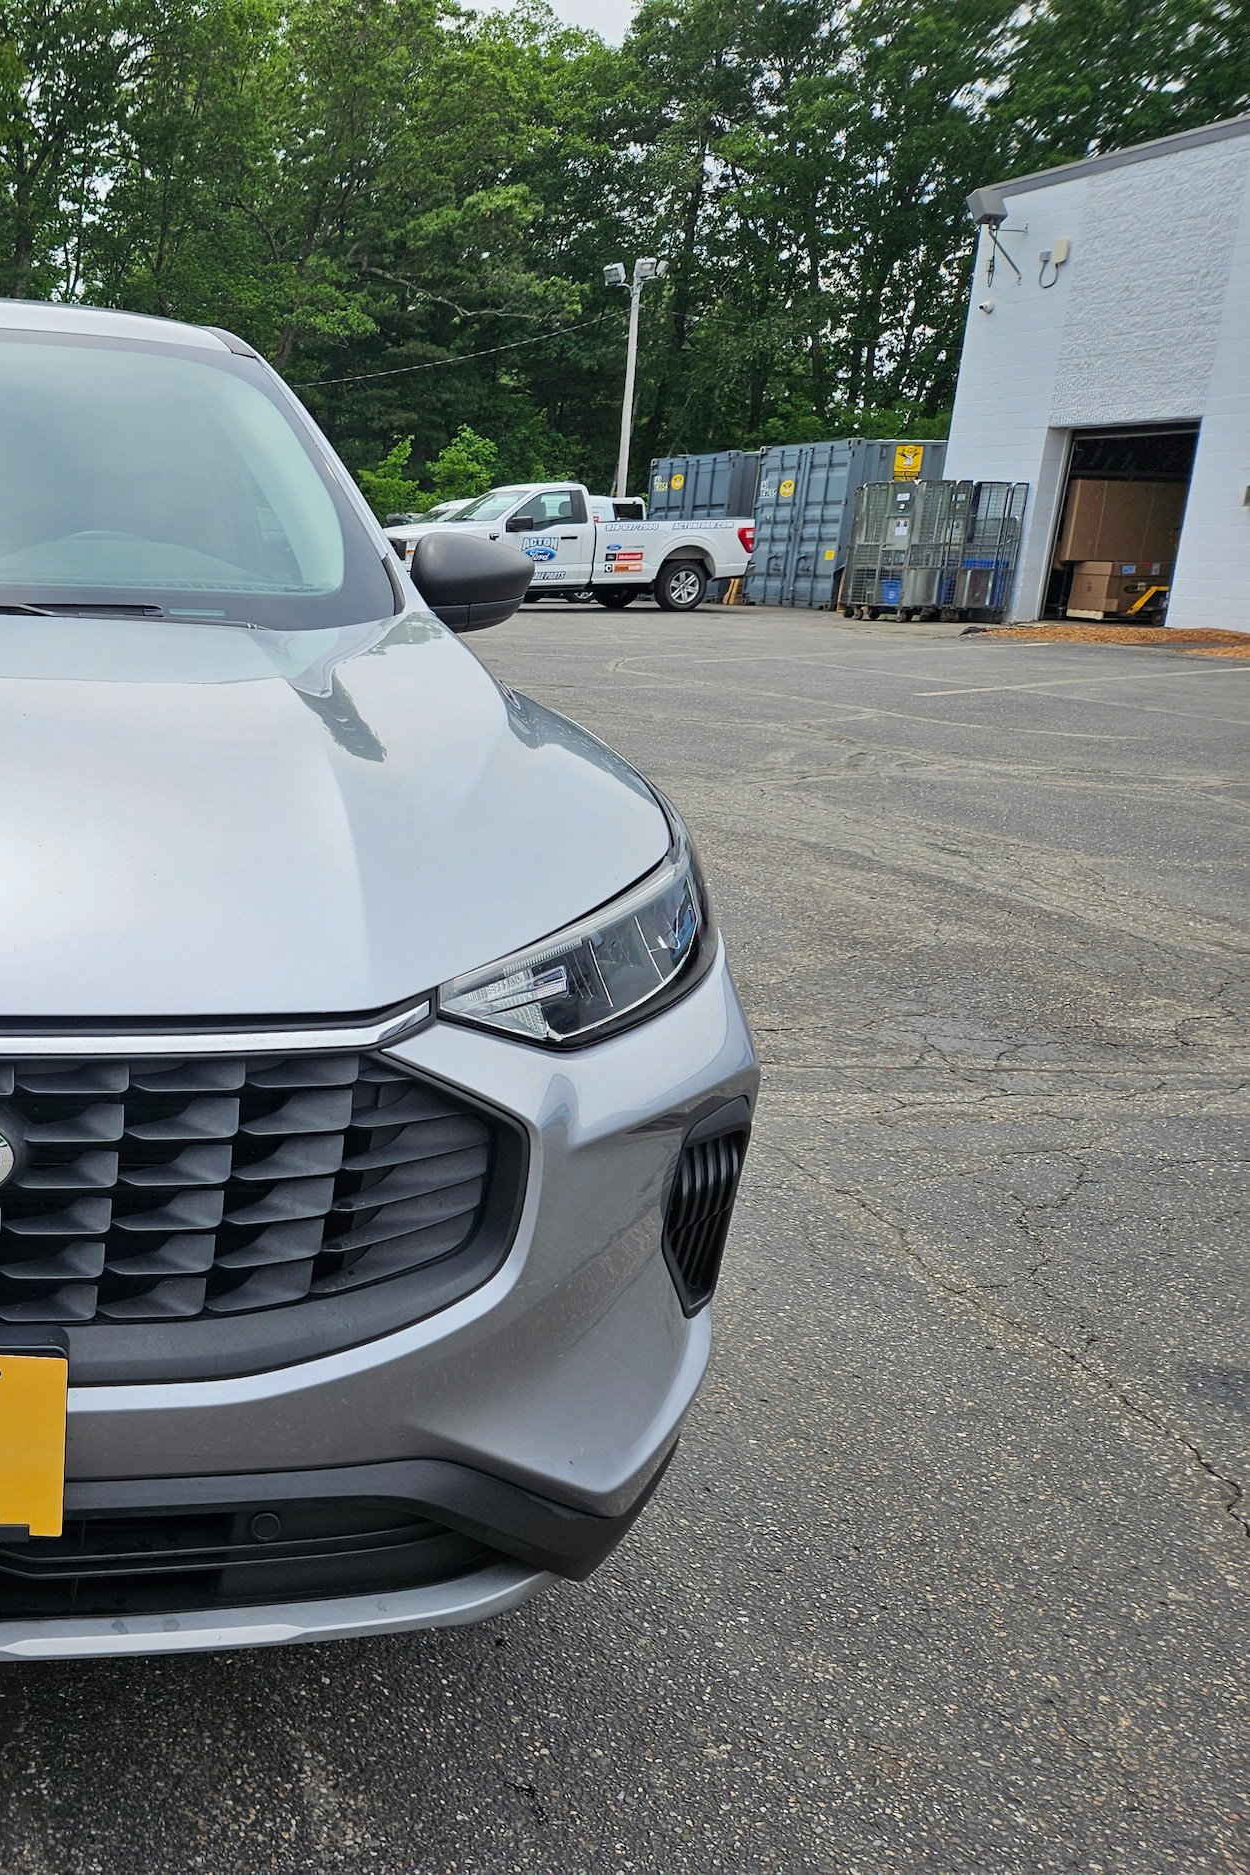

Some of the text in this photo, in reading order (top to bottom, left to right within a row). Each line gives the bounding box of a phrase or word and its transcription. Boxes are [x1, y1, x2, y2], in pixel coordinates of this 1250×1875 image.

[521, 537, 559, 551] ACTON
[529, 549, 551, 561] Ford
[545, 570, 566, 580] PARTS
